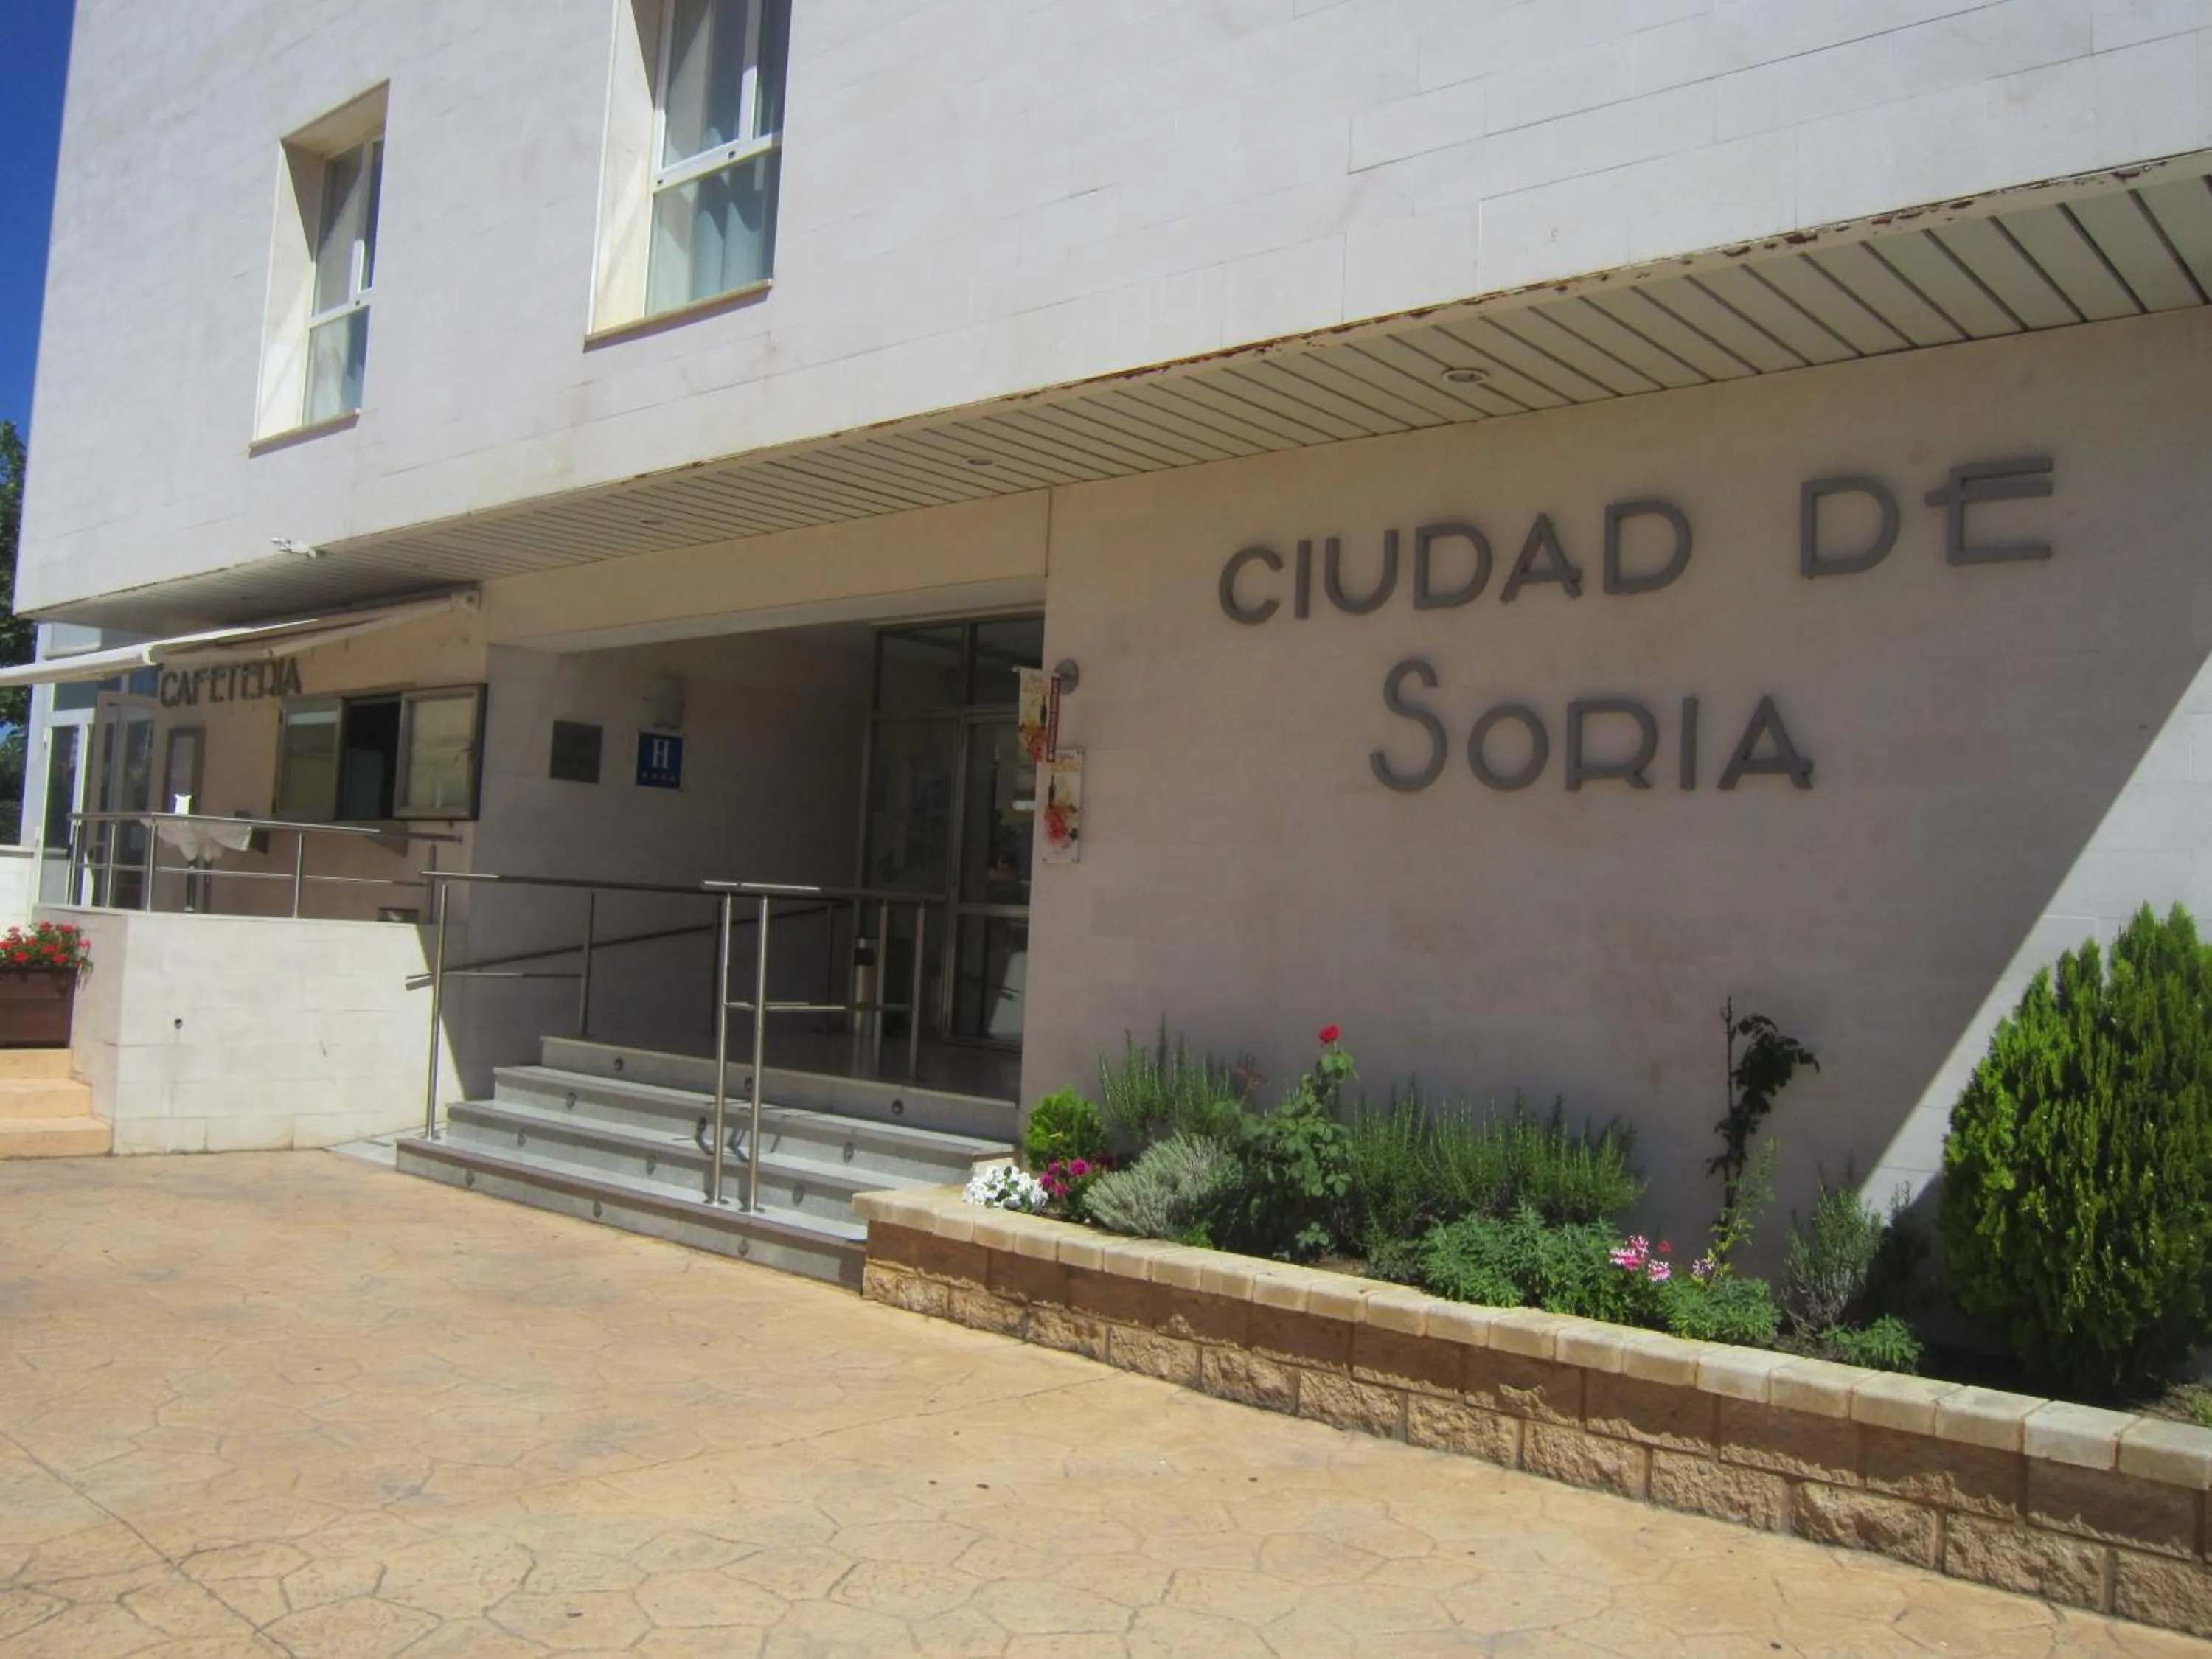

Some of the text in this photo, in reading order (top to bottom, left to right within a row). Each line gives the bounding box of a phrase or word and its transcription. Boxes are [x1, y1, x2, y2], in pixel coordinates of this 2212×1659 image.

[1218, 455, 2053, 625] CIUDAD DE
[161, 657, 302, 706] CAFETERIA
[1368, 658, 1815, 793] SORIA
[651, 738, 671, 769] H
